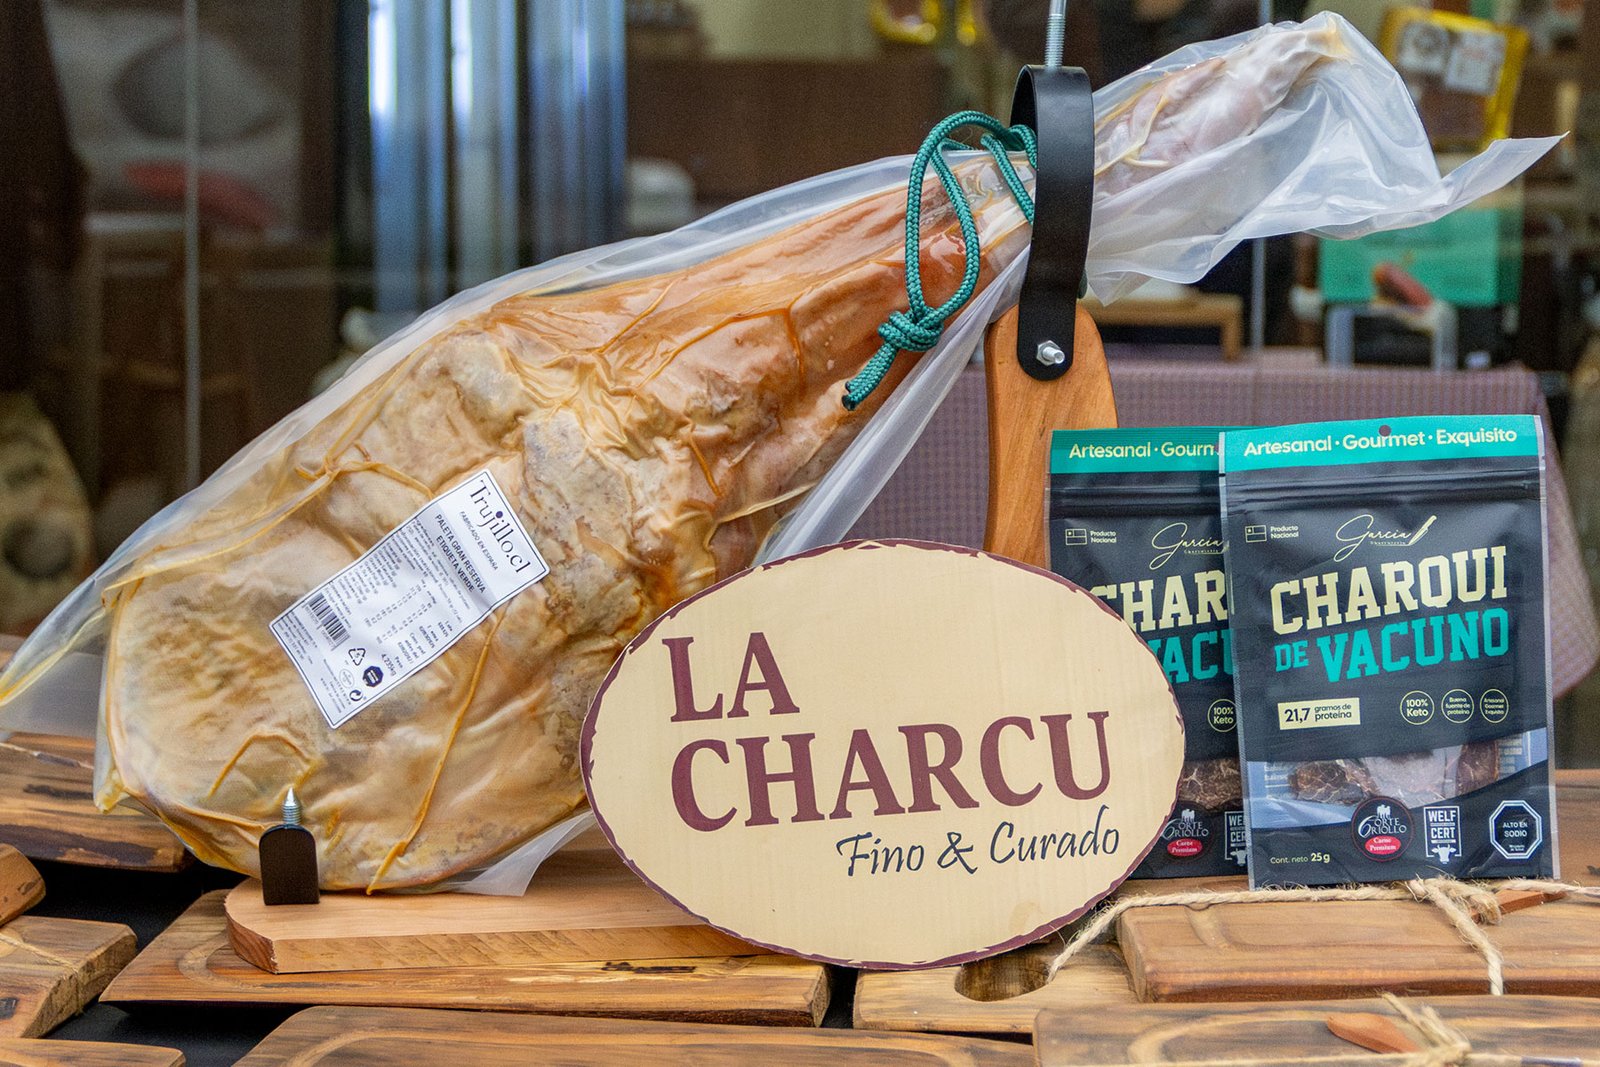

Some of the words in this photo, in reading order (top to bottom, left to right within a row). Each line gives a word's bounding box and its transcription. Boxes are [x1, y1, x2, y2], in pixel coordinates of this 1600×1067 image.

[1243, 436, 1332, 457] Artesanal
[1342, 430, 1425, 451] Gourmet
[1436, 426, 1517, 446] Exquisito
[1069, 442, 1151, 459] Artesanal
[469, 479, 531, 572] Trujillo.cl
[1270, 524, 1299, 532] Producto
[1270, 531, 1299, 540] Nacional
[434, 513, 454, 541] PALETA
[451, 540, 466, 561] GRAN
[463, 559, 485, 593] RESERVA
[435, 535, 459, 569] ETIQUETA
[457, 567, 474, 592] VERDE
[1270, 545, 1508, 635] CHARQUI
[1274, 640, 1310, 672] DE
[1316, 607, 1509, 683] VACUNO
[662, 631, 800, 723] LA
[1213, 707, 1234, 715] 100%
[1314, 704, 1341, 713] gramos
[1406, 698, 1429, 708] 100%
[1213, 716, 1234, 724] Keto
[1284, 707, 1311, 723] 21,7
[1406, 708, 1429, 717] Keto
[671, 710, 1110, 832] CHARCU
[1428, 810, 1456, 822] WELF
[836, 832, 924, 877] Fino
[937, 832, 978, 874] &
[990, 805, 1120, 864] Curado
[1430, 827, 1456, 839] CERT
